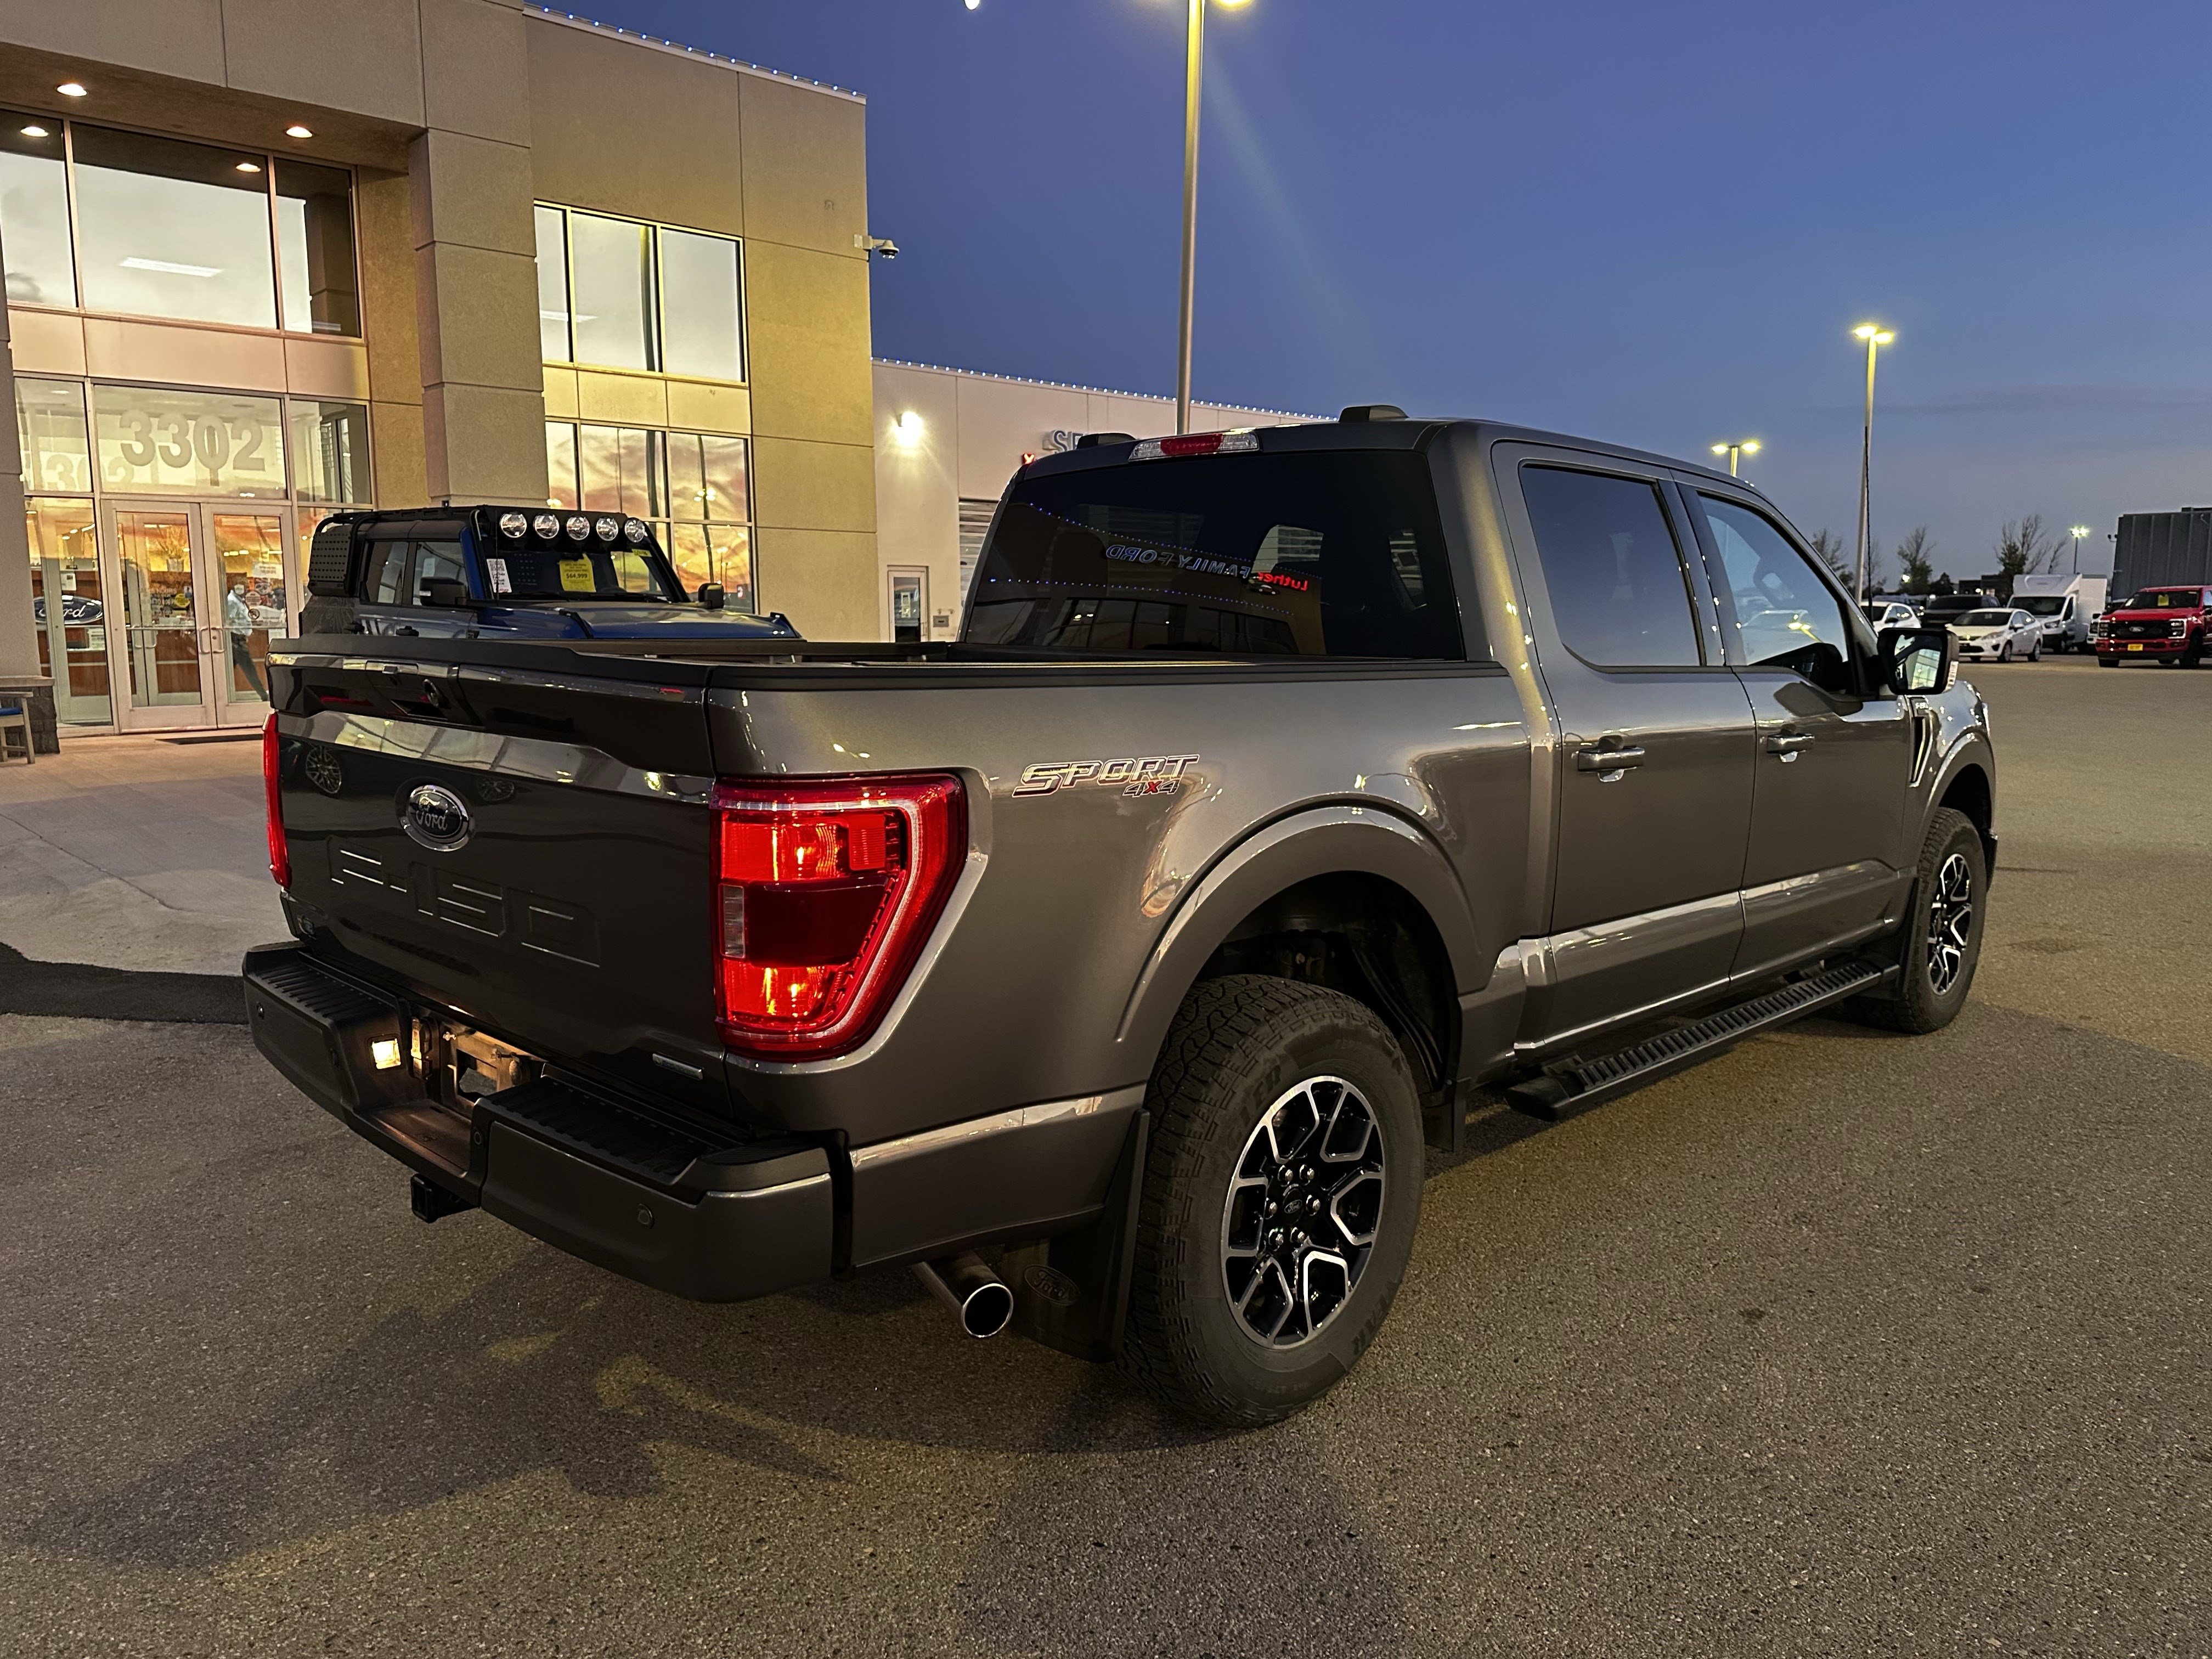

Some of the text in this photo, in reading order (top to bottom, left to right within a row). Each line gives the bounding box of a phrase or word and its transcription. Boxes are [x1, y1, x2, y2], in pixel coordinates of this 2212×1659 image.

[119, 409, 266, 471] 3302
[1012, 754, 1200, 798] SPORT
[415, 795, 448, 831] Ford
[326, 834, 601, 968] F-150
